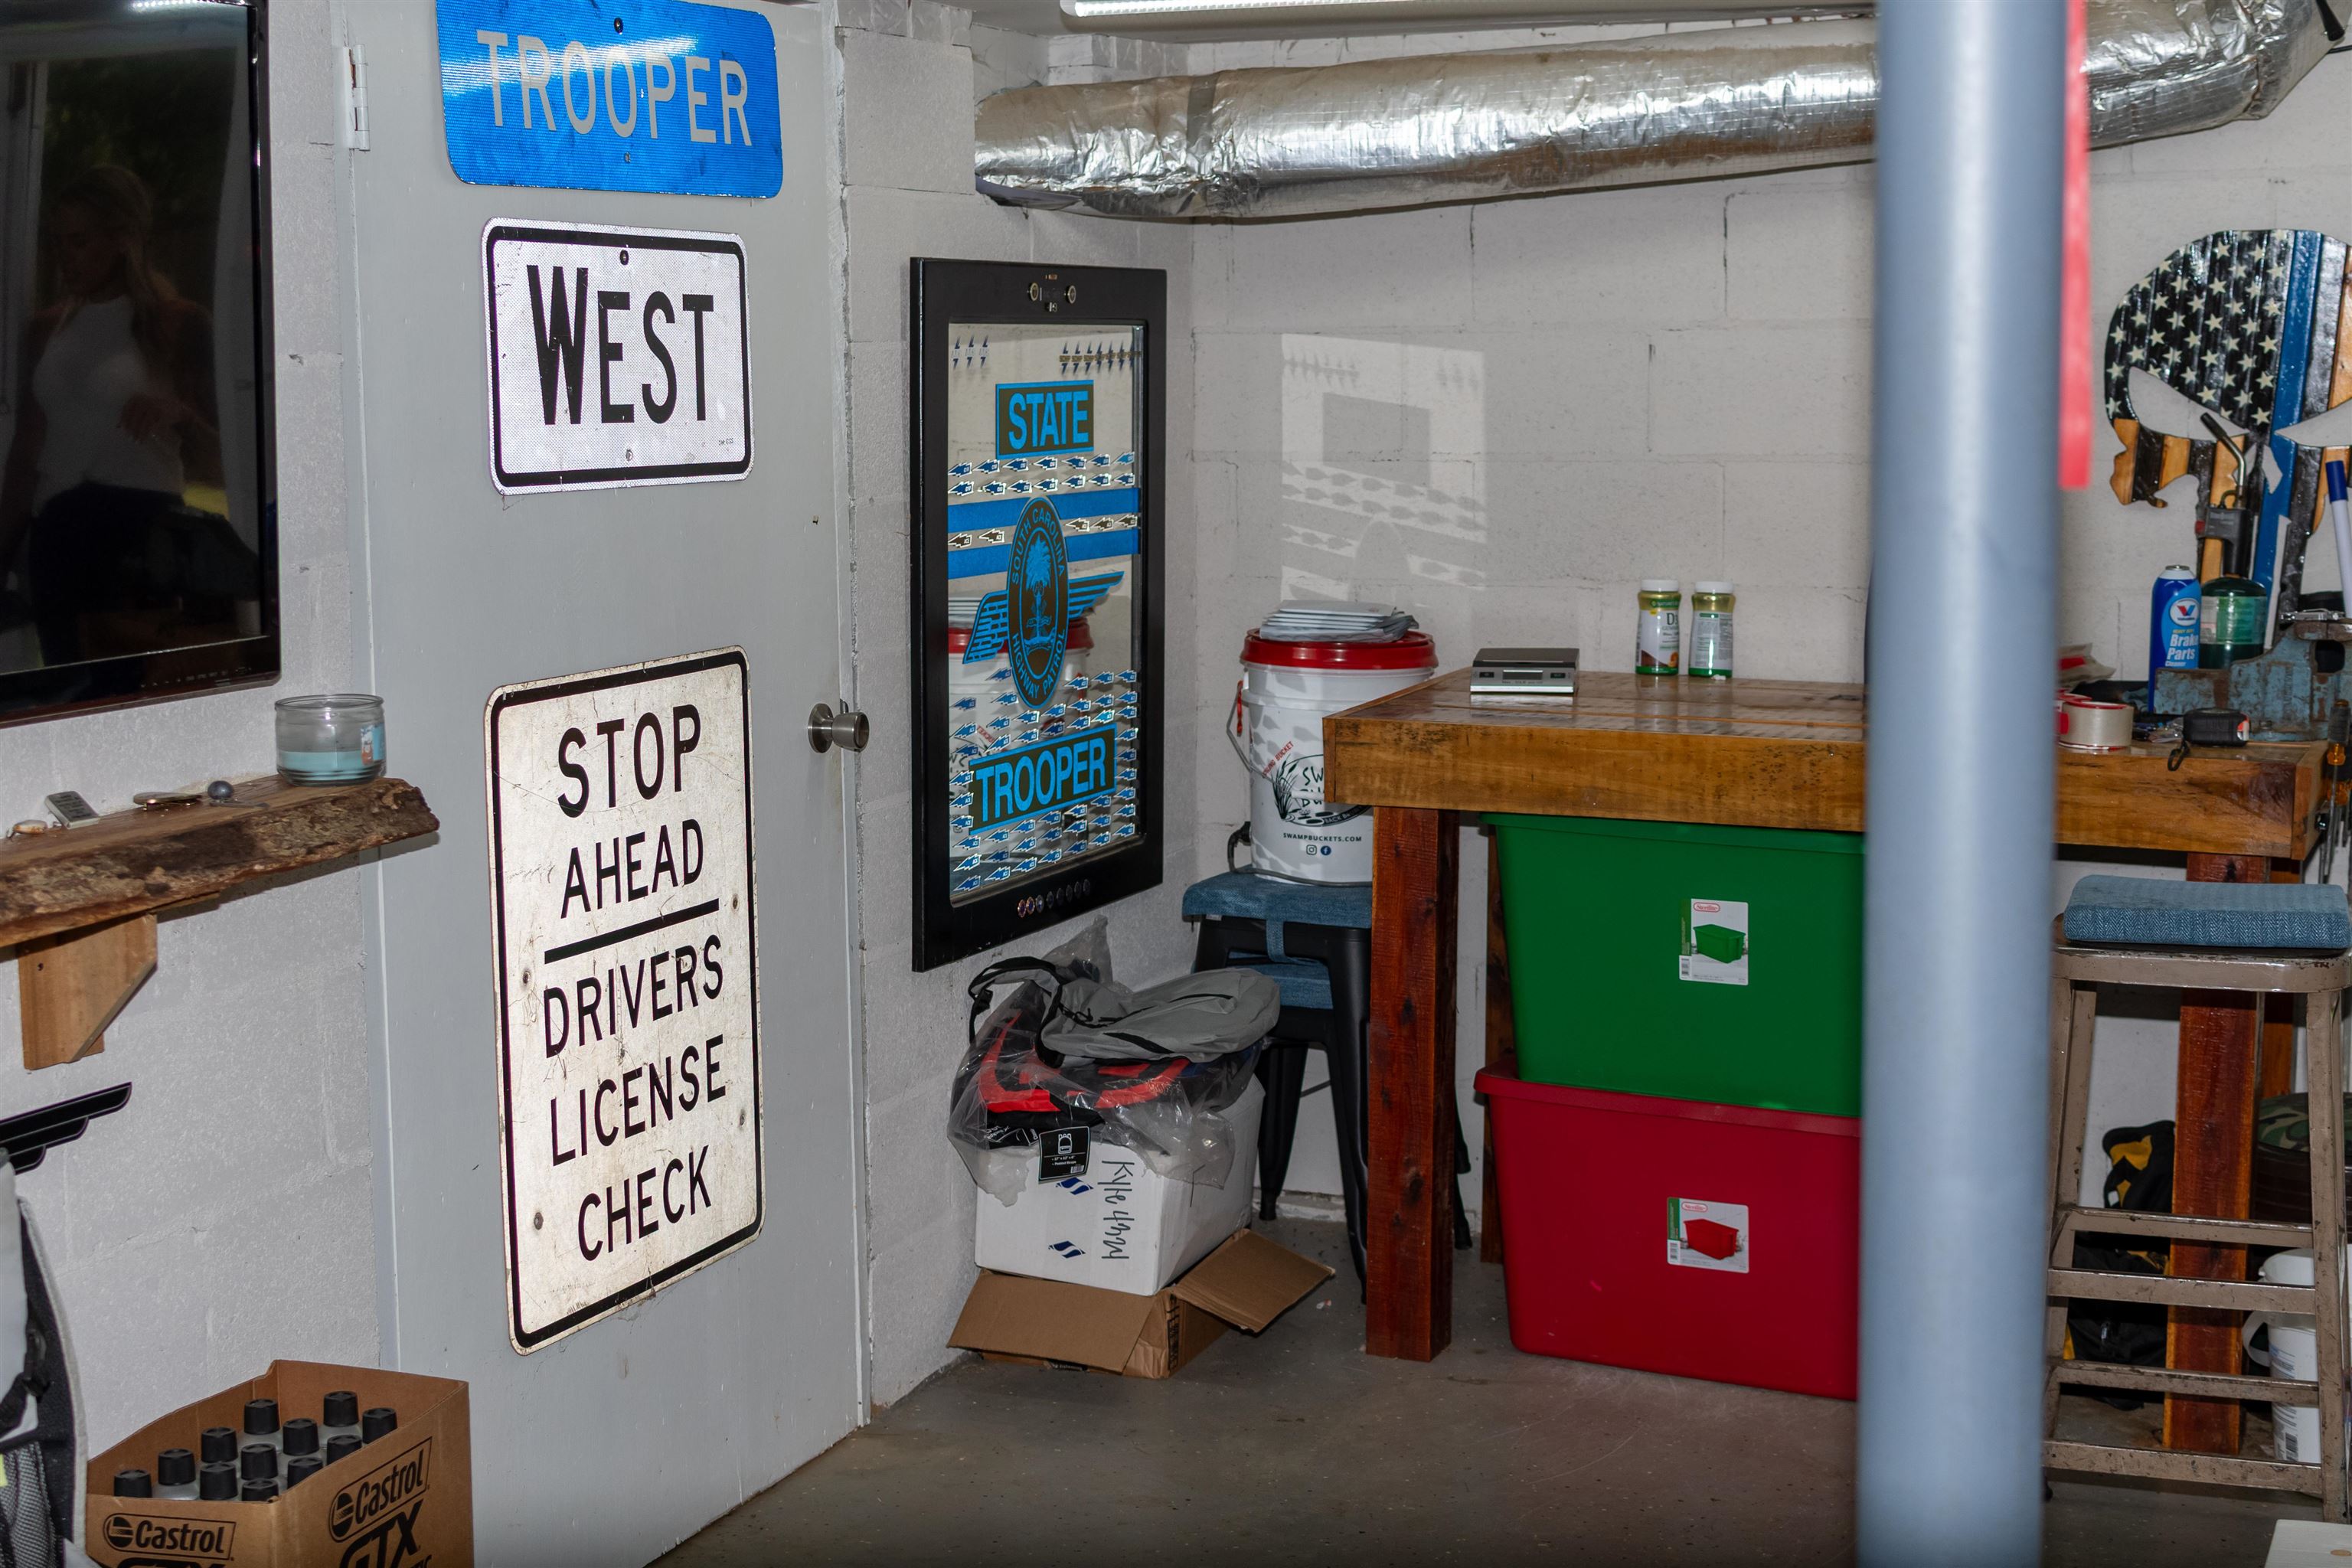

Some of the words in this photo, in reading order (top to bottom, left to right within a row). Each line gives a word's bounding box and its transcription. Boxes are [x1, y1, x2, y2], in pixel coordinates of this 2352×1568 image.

[477, 29, 753, 146] TROOPER
[527, 264, 714, 425] WEST
[1008, 390, 1089, 450] STATE
[1011, 520, 1032, 584] SOUTH
[1034, 508, 1065, 577] CAROLINA
[1012, 632, 1040, 698] HIGHWAY
[1042, 629, 1066, 695] PATROL
[2167, 647, 2196, 660] Parts
[557, 704, 701, 818] STOP
[975, 737, 1107, 822] TROOPER
[560, 819, 704, 920] AHEAD
[1283, 832, 1362, 842] SWAMPBUCKETS.COM
[544, 934, 724, 1058] DRIVERS
[550, 1034, 727, 1166] LICENSE
[577, 1145, 712, 1263] CHECK
[1097, 1160, 1135, 1204] Kyle
[355, 1449, 424, 1524] Castrol
[136, 1519, 225, 1553] Castrol
